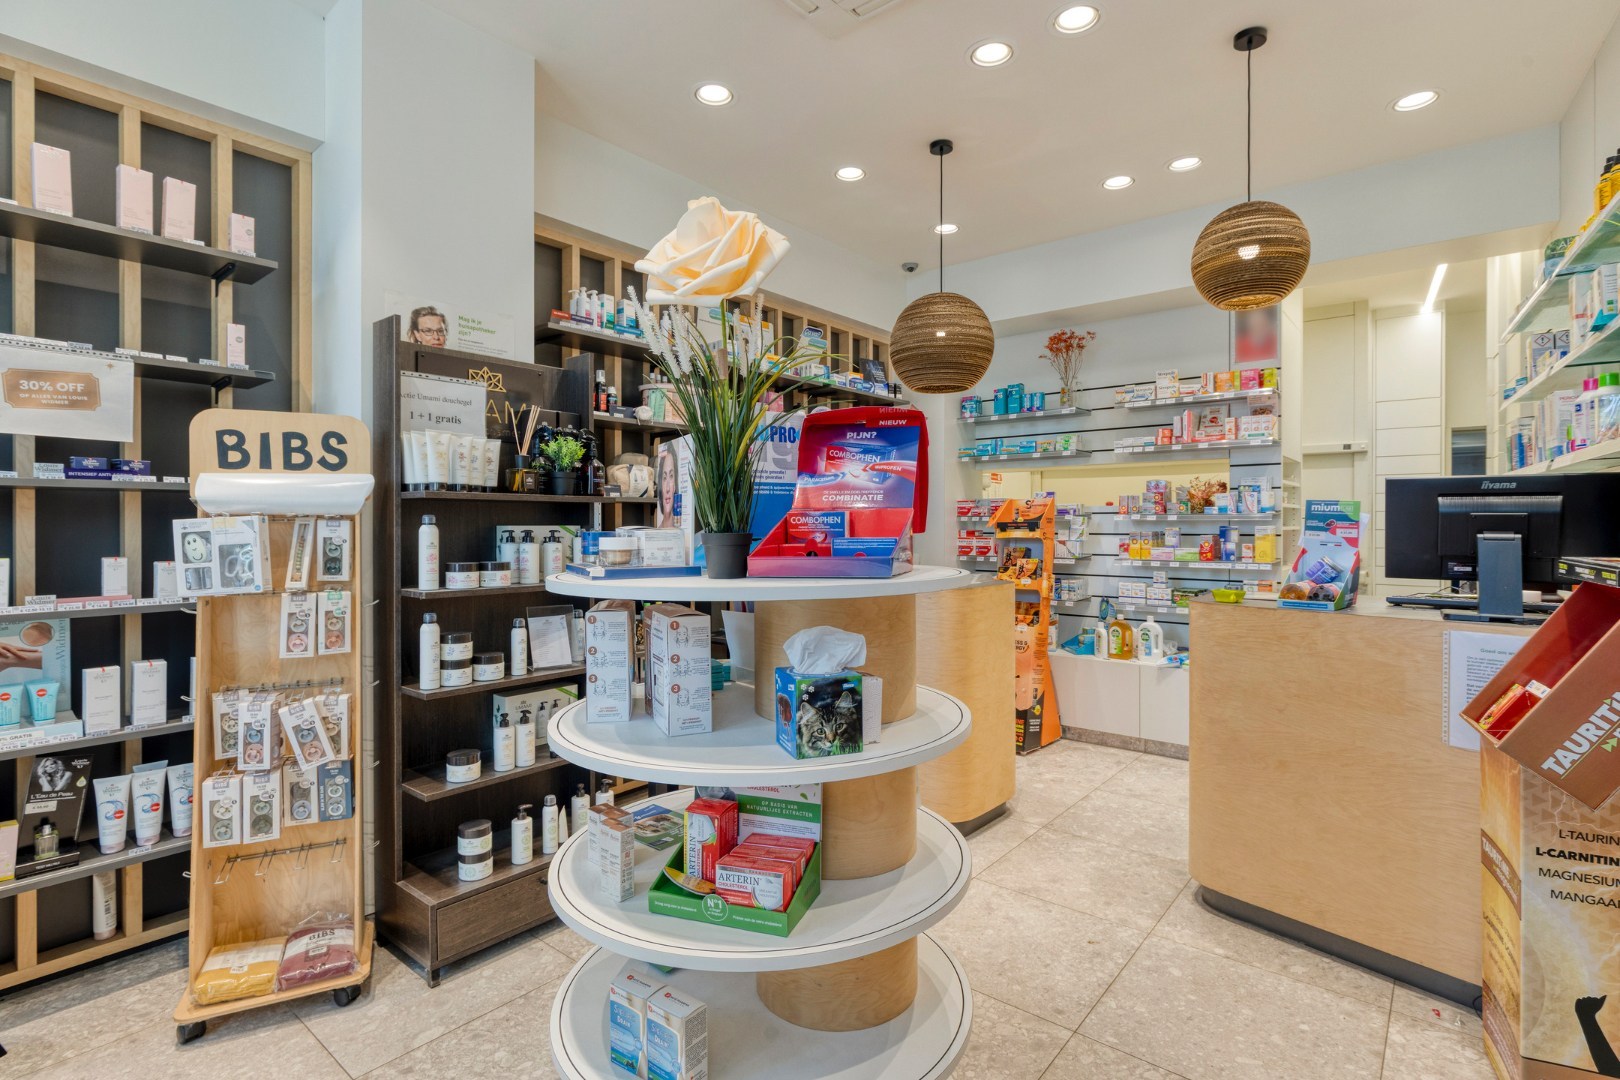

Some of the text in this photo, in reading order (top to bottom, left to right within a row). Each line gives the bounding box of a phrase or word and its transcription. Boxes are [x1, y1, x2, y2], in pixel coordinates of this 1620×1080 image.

[19, 380, 85, 393] 30% OFF
[417, 393, 440, 402] Umami
[442, 396, 472, 406] douchegel
[410, 411, 414, 420] 1
[427, 412, 432, 421] 1
[435, 413, 462, 424] gratis
[846, 431, 877, 439] PIJN?
[216, 428, 348, 471] BIBS
[829, 449, 881, 462] COMBOPHEN
[1481, 481, 1517, 489] iiyama
[1311, 504, 1340, 512] mium
[790, 516, 841, 524] COMBOPHEN
[718, 872, 760, 886] ARTERIN
[1550, 889, 1620, 909] MANGAA
[308, 928, 336, 942] BIBS
